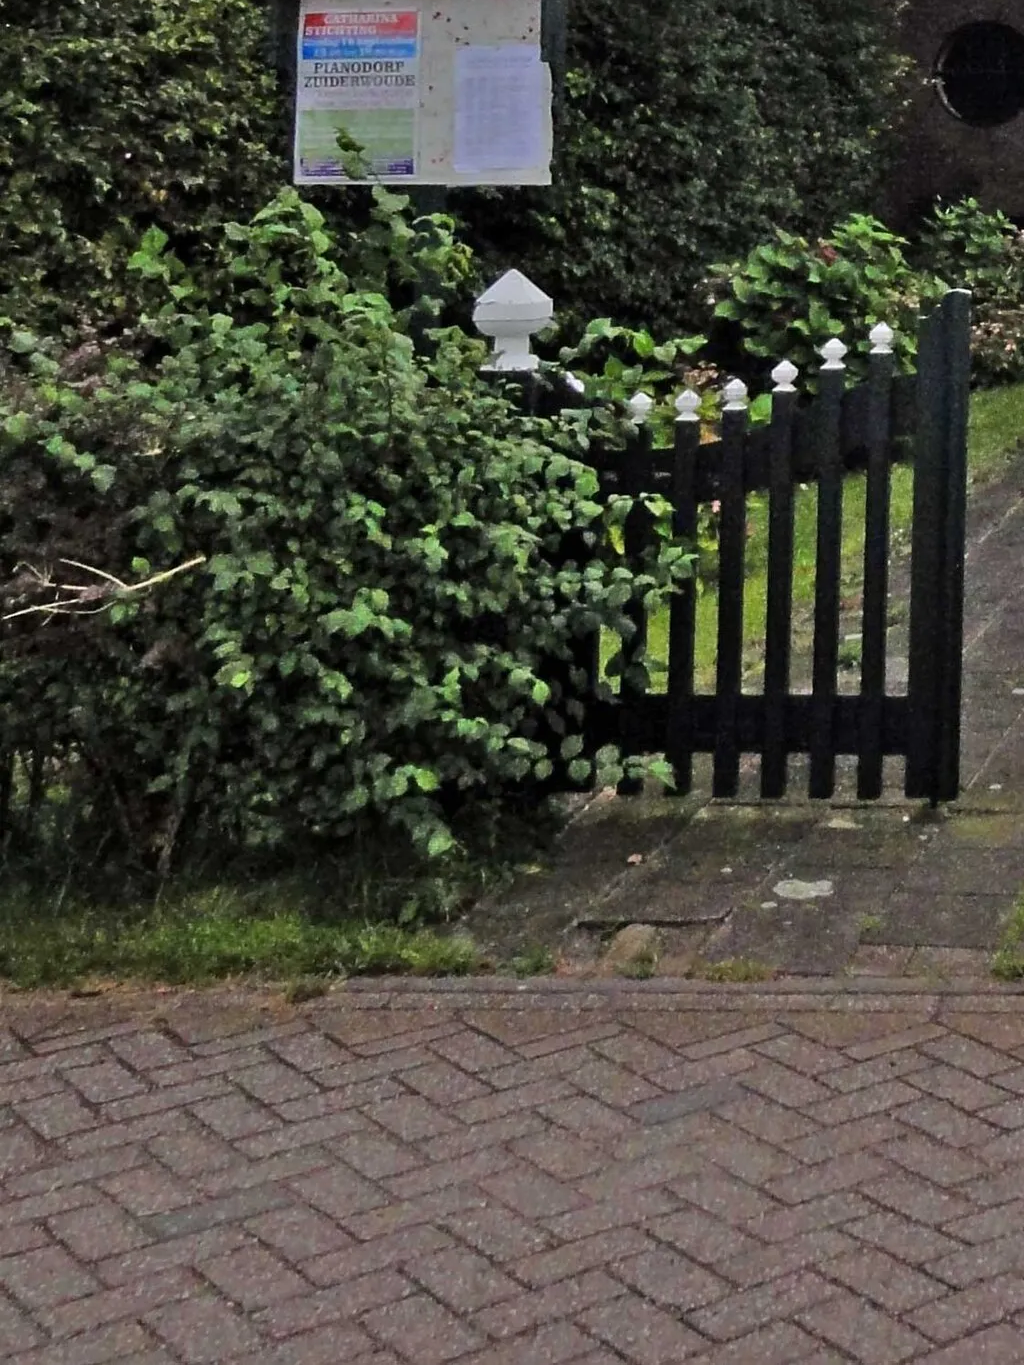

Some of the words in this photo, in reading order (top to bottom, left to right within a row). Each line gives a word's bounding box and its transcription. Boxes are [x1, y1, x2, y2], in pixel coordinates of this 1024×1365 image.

[305, 25, 377, 36] STICHTING
[314, 61, 404, 73] PIANODORP
[304, 75, 415, 87] ZUIDERWOUDE
